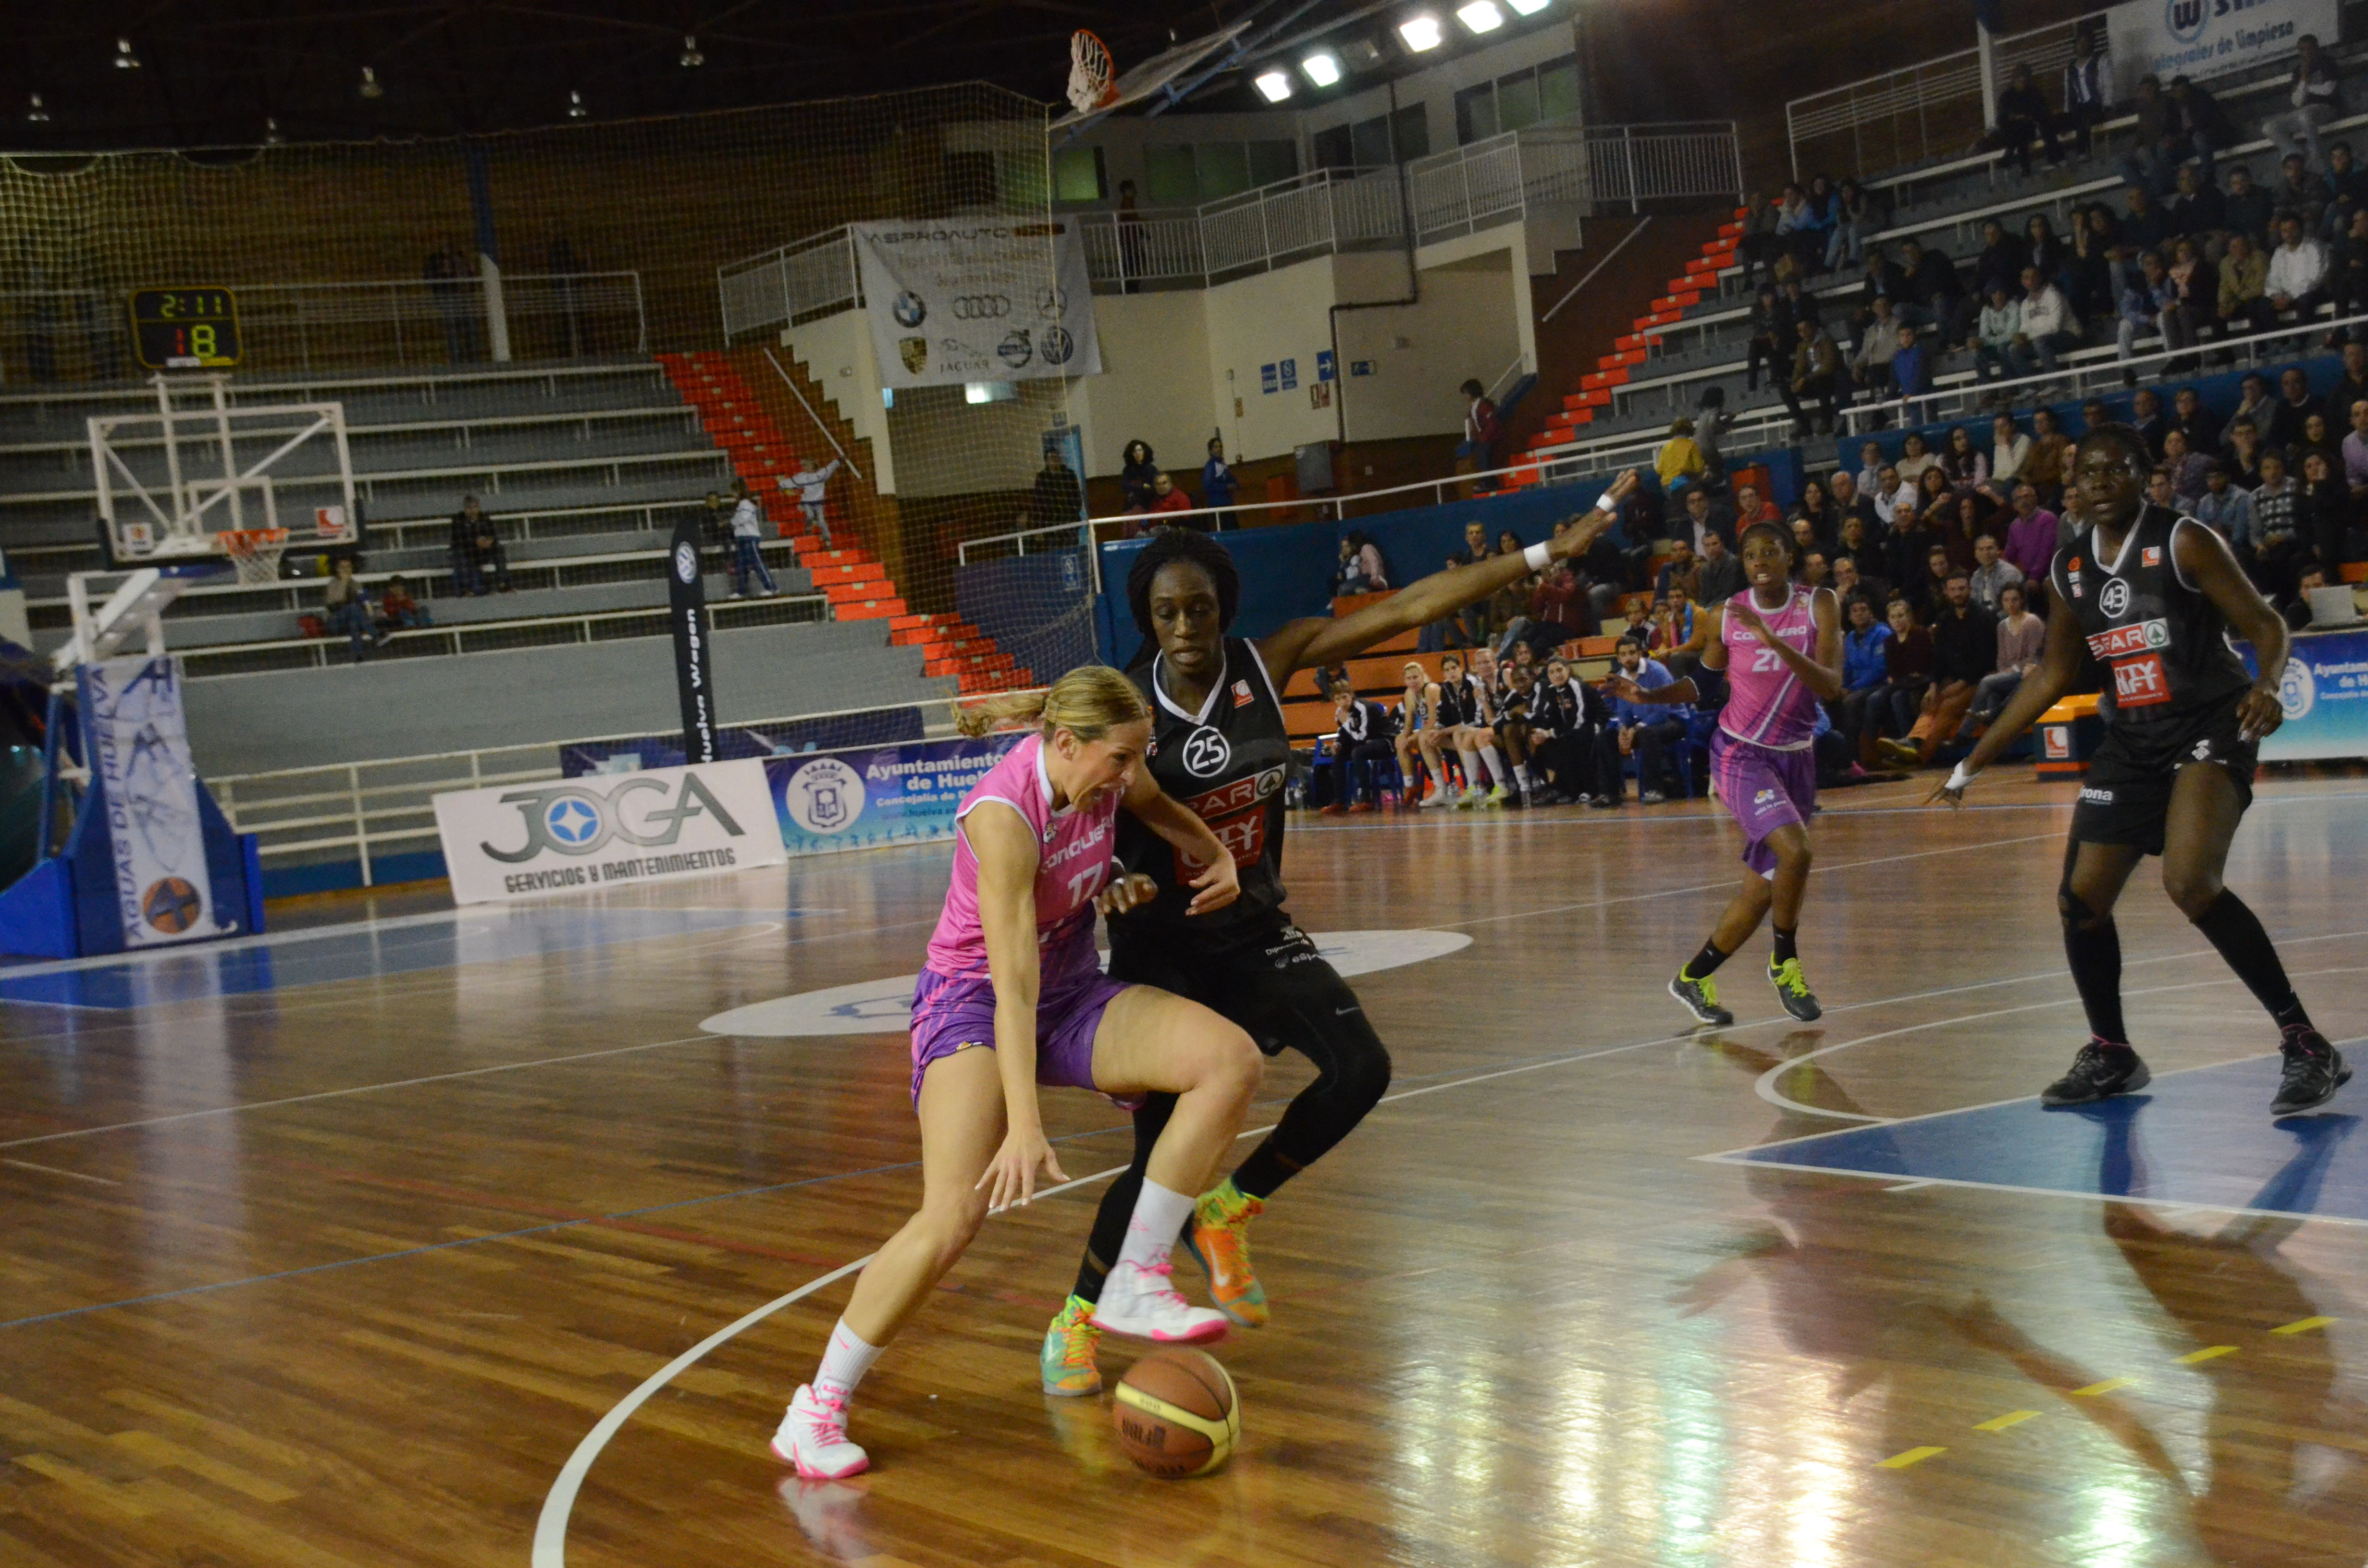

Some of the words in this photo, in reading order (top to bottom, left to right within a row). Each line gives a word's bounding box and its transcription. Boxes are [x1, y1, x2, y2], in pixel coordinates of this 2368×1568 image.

[160, 294, 222, 318] 2:11
[940, 360, 990, 373] JAGUAR
[2103, 585, 2127, 610] 43
[687, 609, 702, 688] Wagen
[866, 752, 1004, 782] Ayuntamiento
[1189, 735, 1221, 770] 25
[907, 775, 932, 791] de
[940, 792, 955, 801] de
[480, 771, 746, 863] JOGA
[505, 866, 585, 893] SERVICIOS
[602, 847, 737, 881] MANTENIMIENTOS
[1068, 861, 1104, 909] 17
